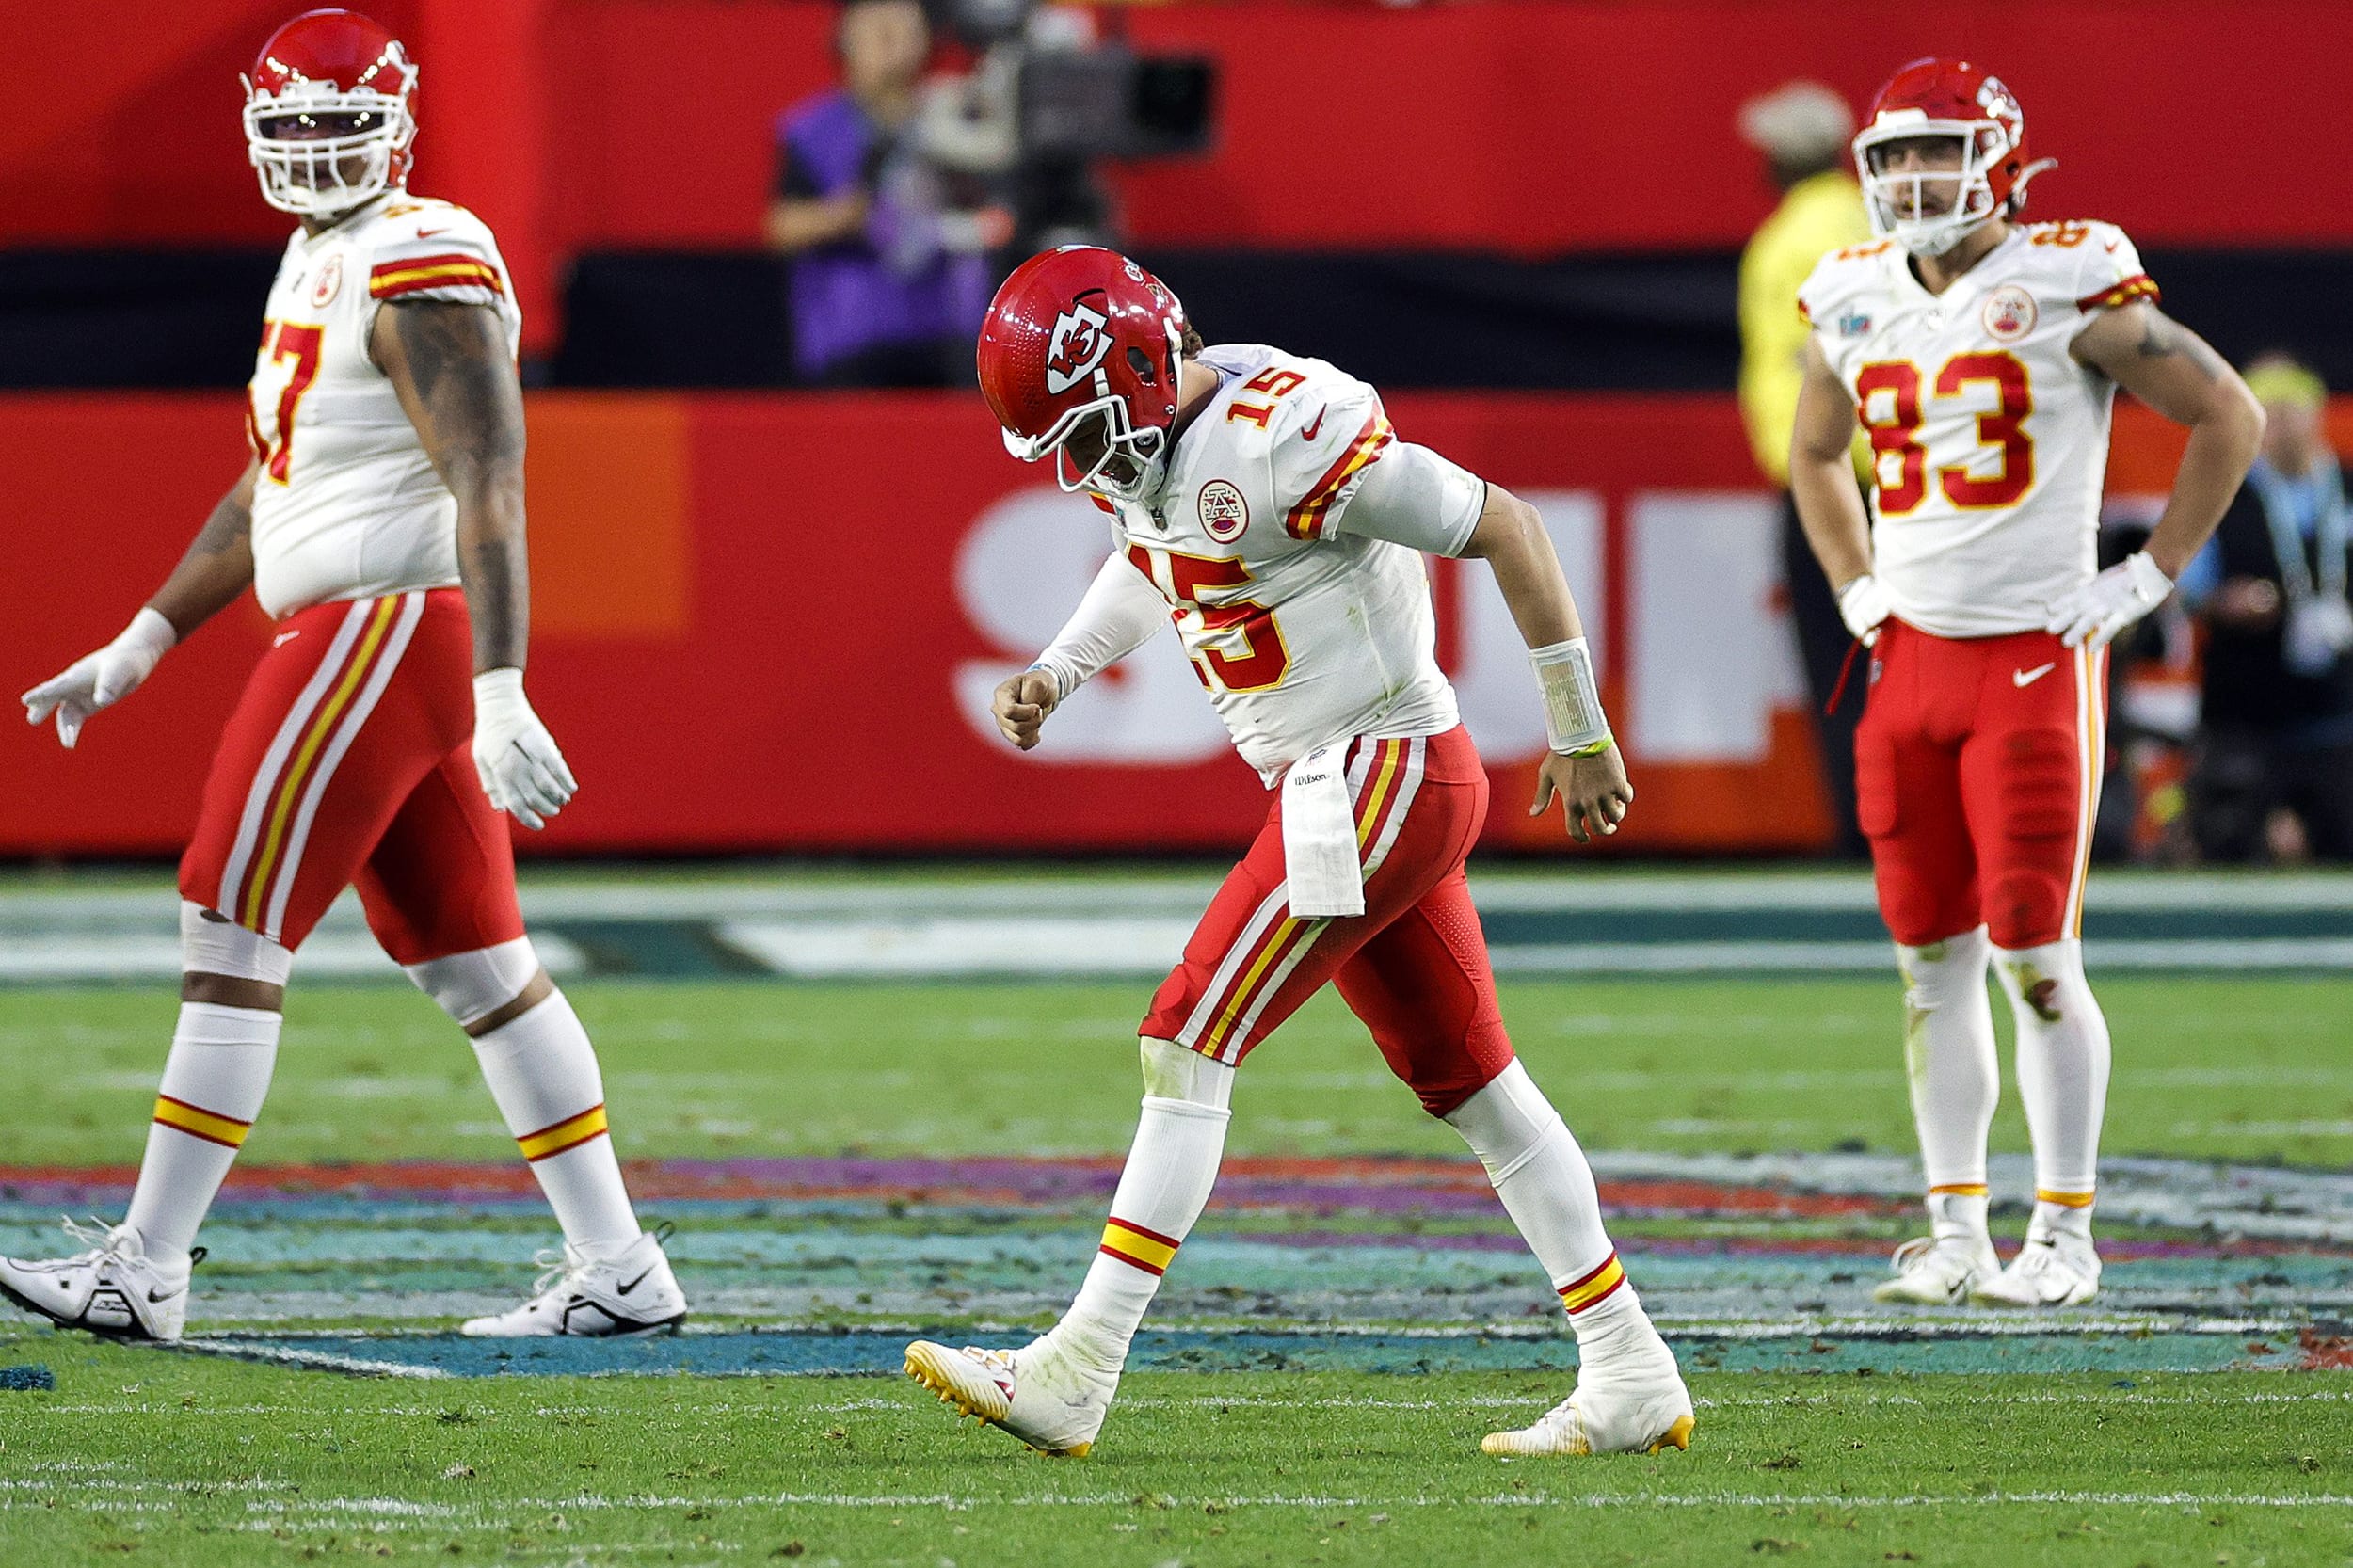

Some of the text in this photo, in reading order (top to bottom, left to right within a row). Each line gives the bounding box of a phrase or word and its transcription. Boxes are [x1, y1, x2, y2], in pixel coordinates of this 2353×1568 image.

[1226, 366, 1307, 430] 15
[1856, 349, 2036, 517] 83
[1294, 773, 1327, 786] Wilson
